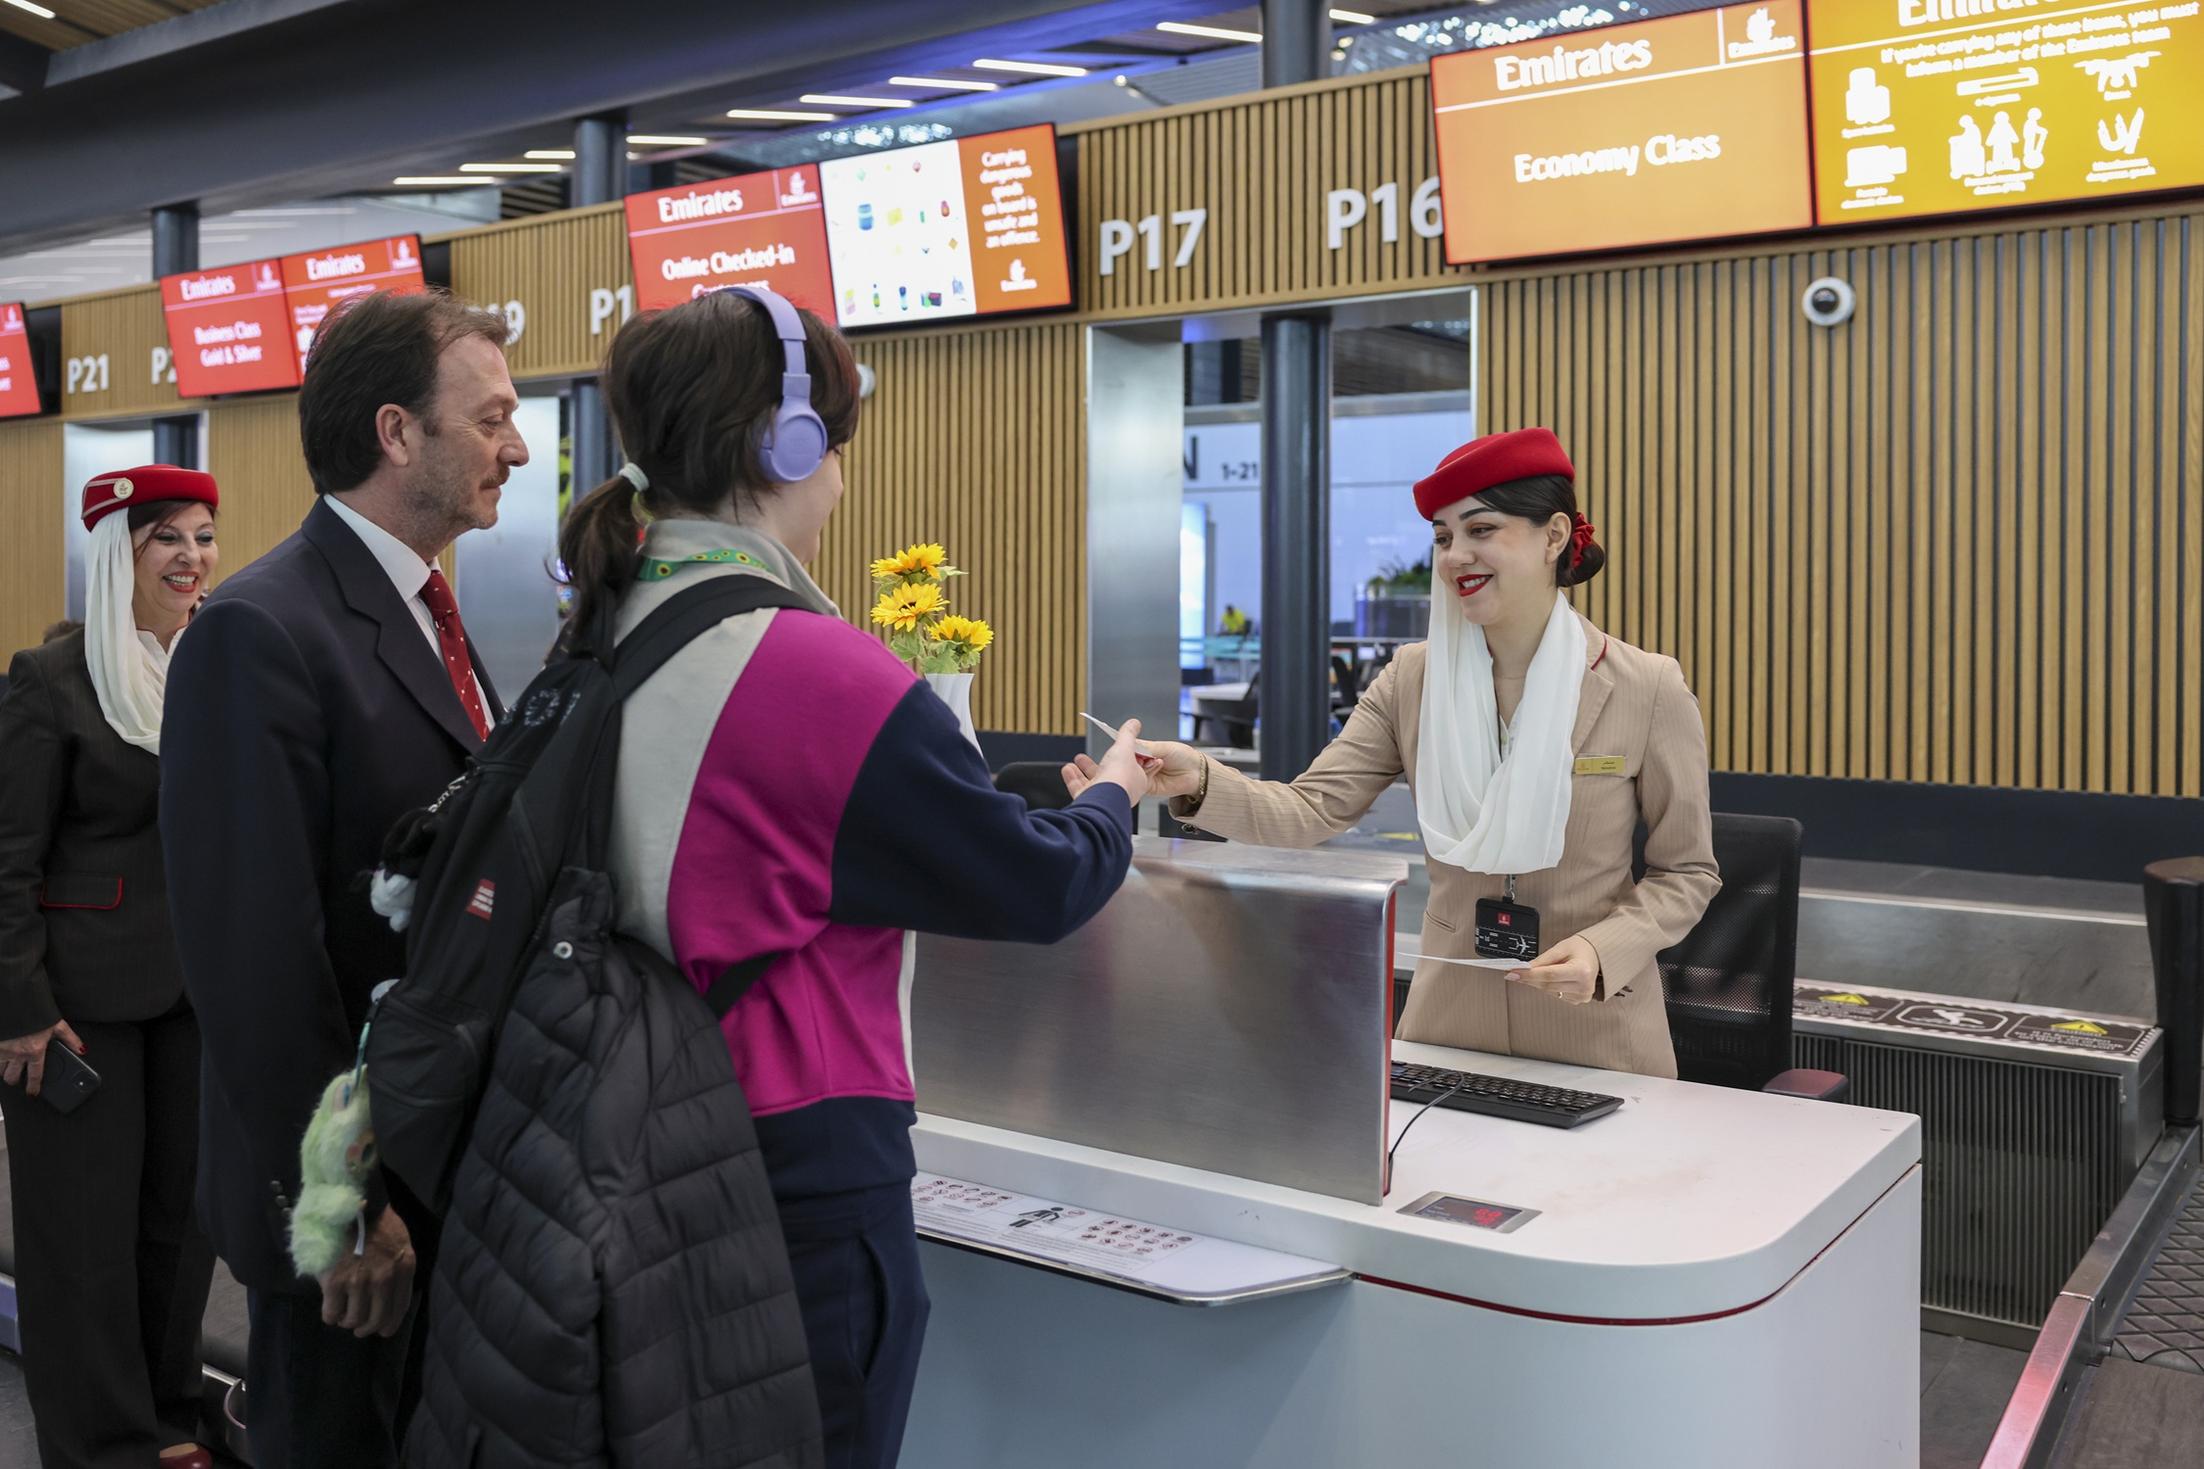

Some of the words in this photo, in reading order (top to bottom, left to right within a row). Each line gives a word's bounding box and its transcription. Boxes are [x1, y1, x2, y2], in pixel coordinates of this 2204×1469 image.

[1494, 40, 1652, 91] Emirates
[1514, 145, 1639, 183] Economy
[1645, 134, 1721, 166] Class
[657, 189, 743, 222] Emirates
[1327, 176, 1444, 250] P16
[662, 256, 710, 280] Online
[710, 243, 796, 274] Checked-in
[1100, 208, 1207, 276] P17
[67, 354, 109, 394] P21
